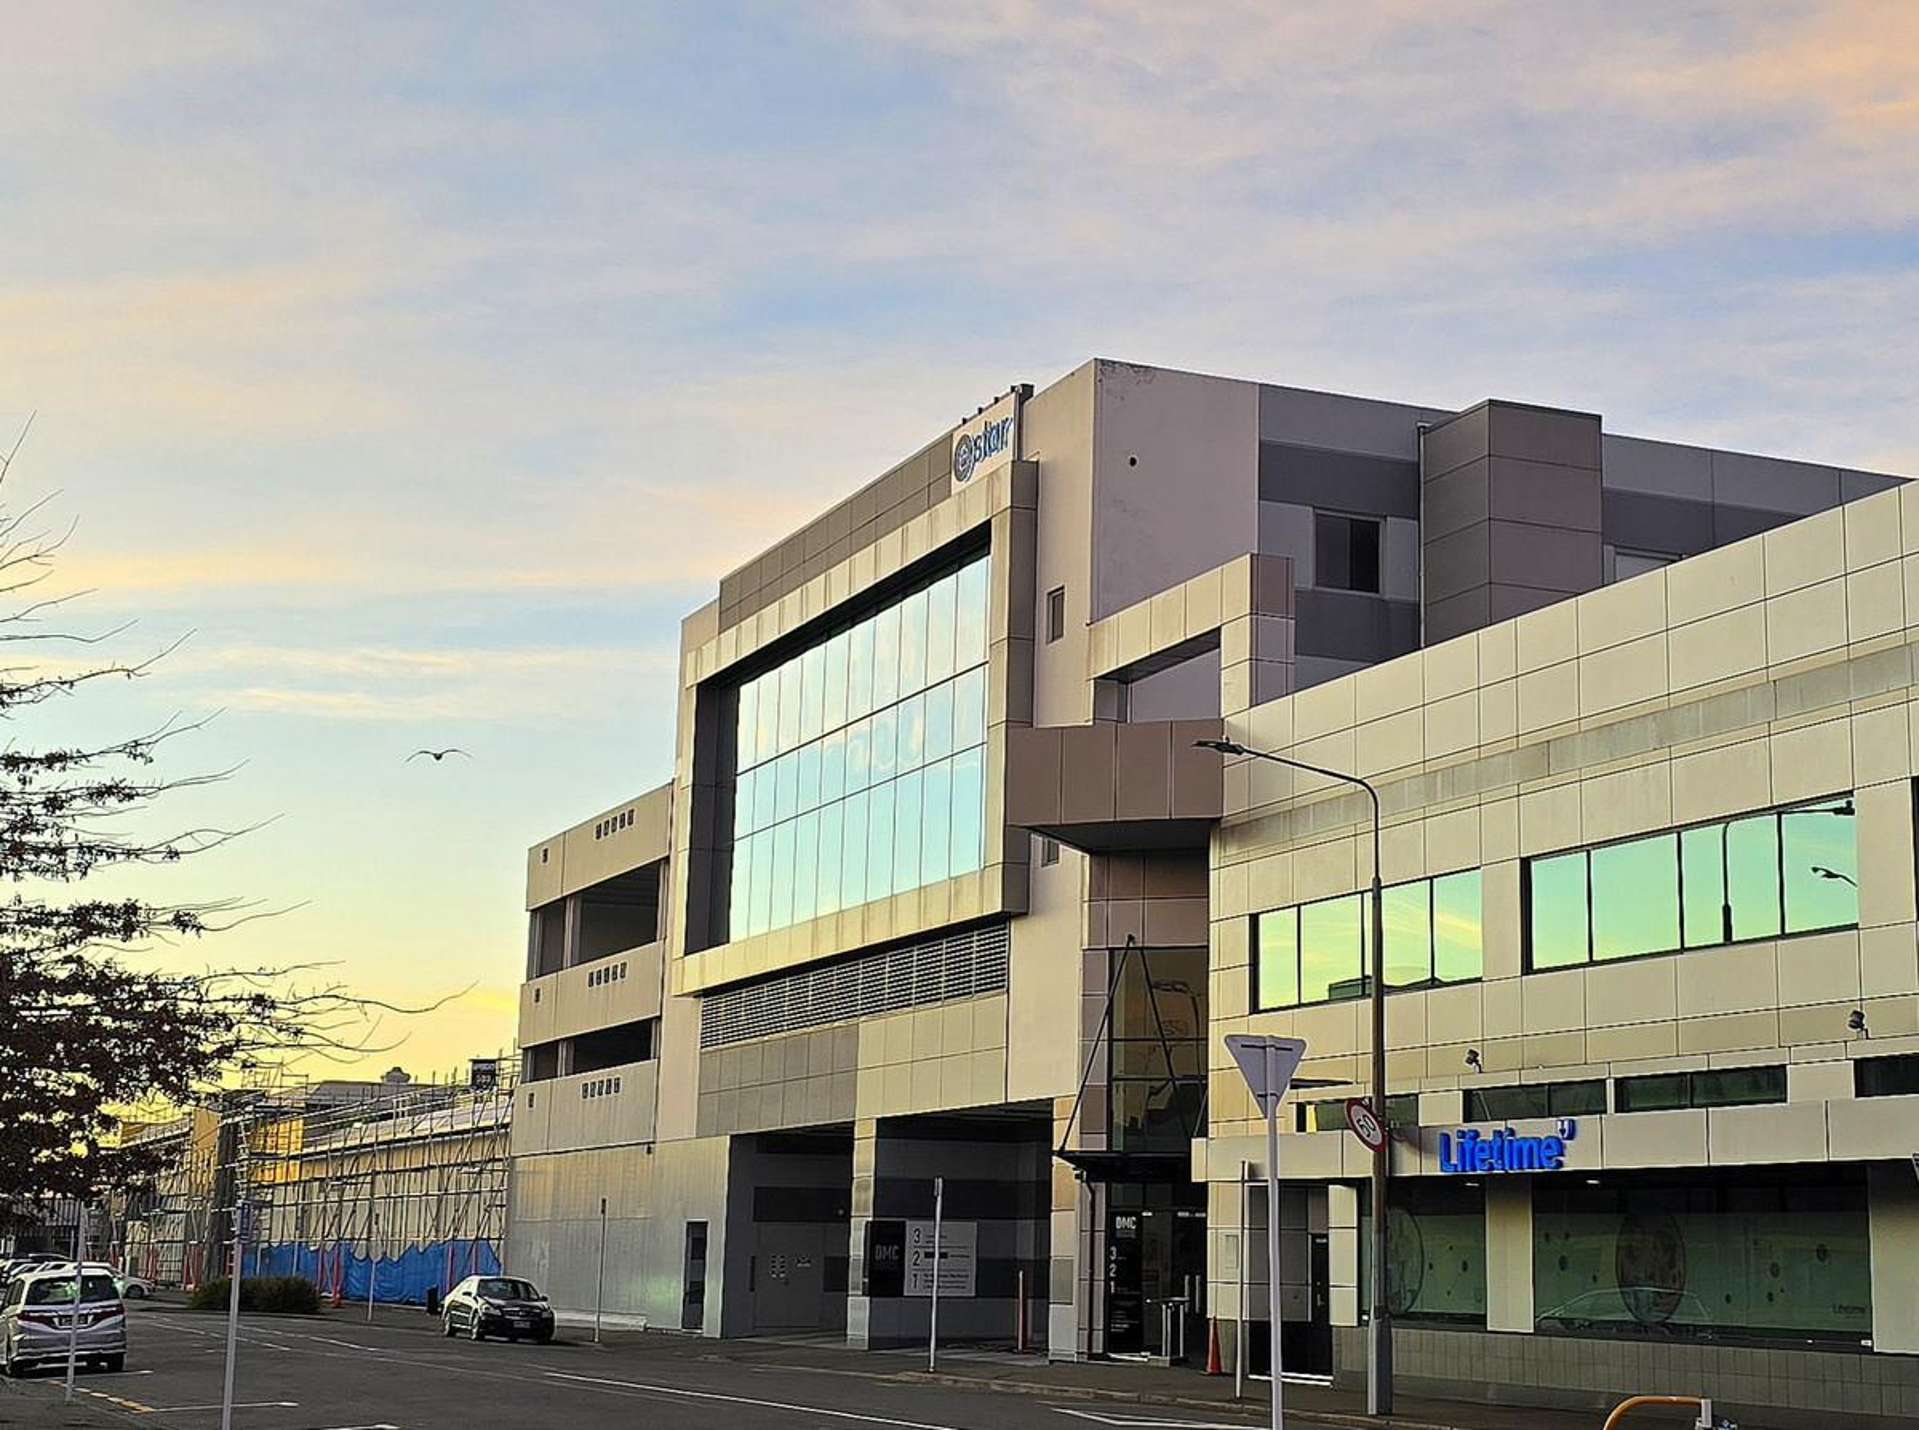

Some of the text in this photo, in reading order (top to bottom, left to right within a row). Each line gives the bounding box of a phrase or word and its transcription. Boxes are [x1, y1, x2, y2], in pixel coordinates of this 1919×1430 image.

[1356, 1114, 1376, 1137] 50
[1438, 1127, 1565, 1173] Lifetime
[913, 1228, 922, 1245] 3
[912, 1250, 921, 1267] 2
[912, 1273, 919, 1289] 1
